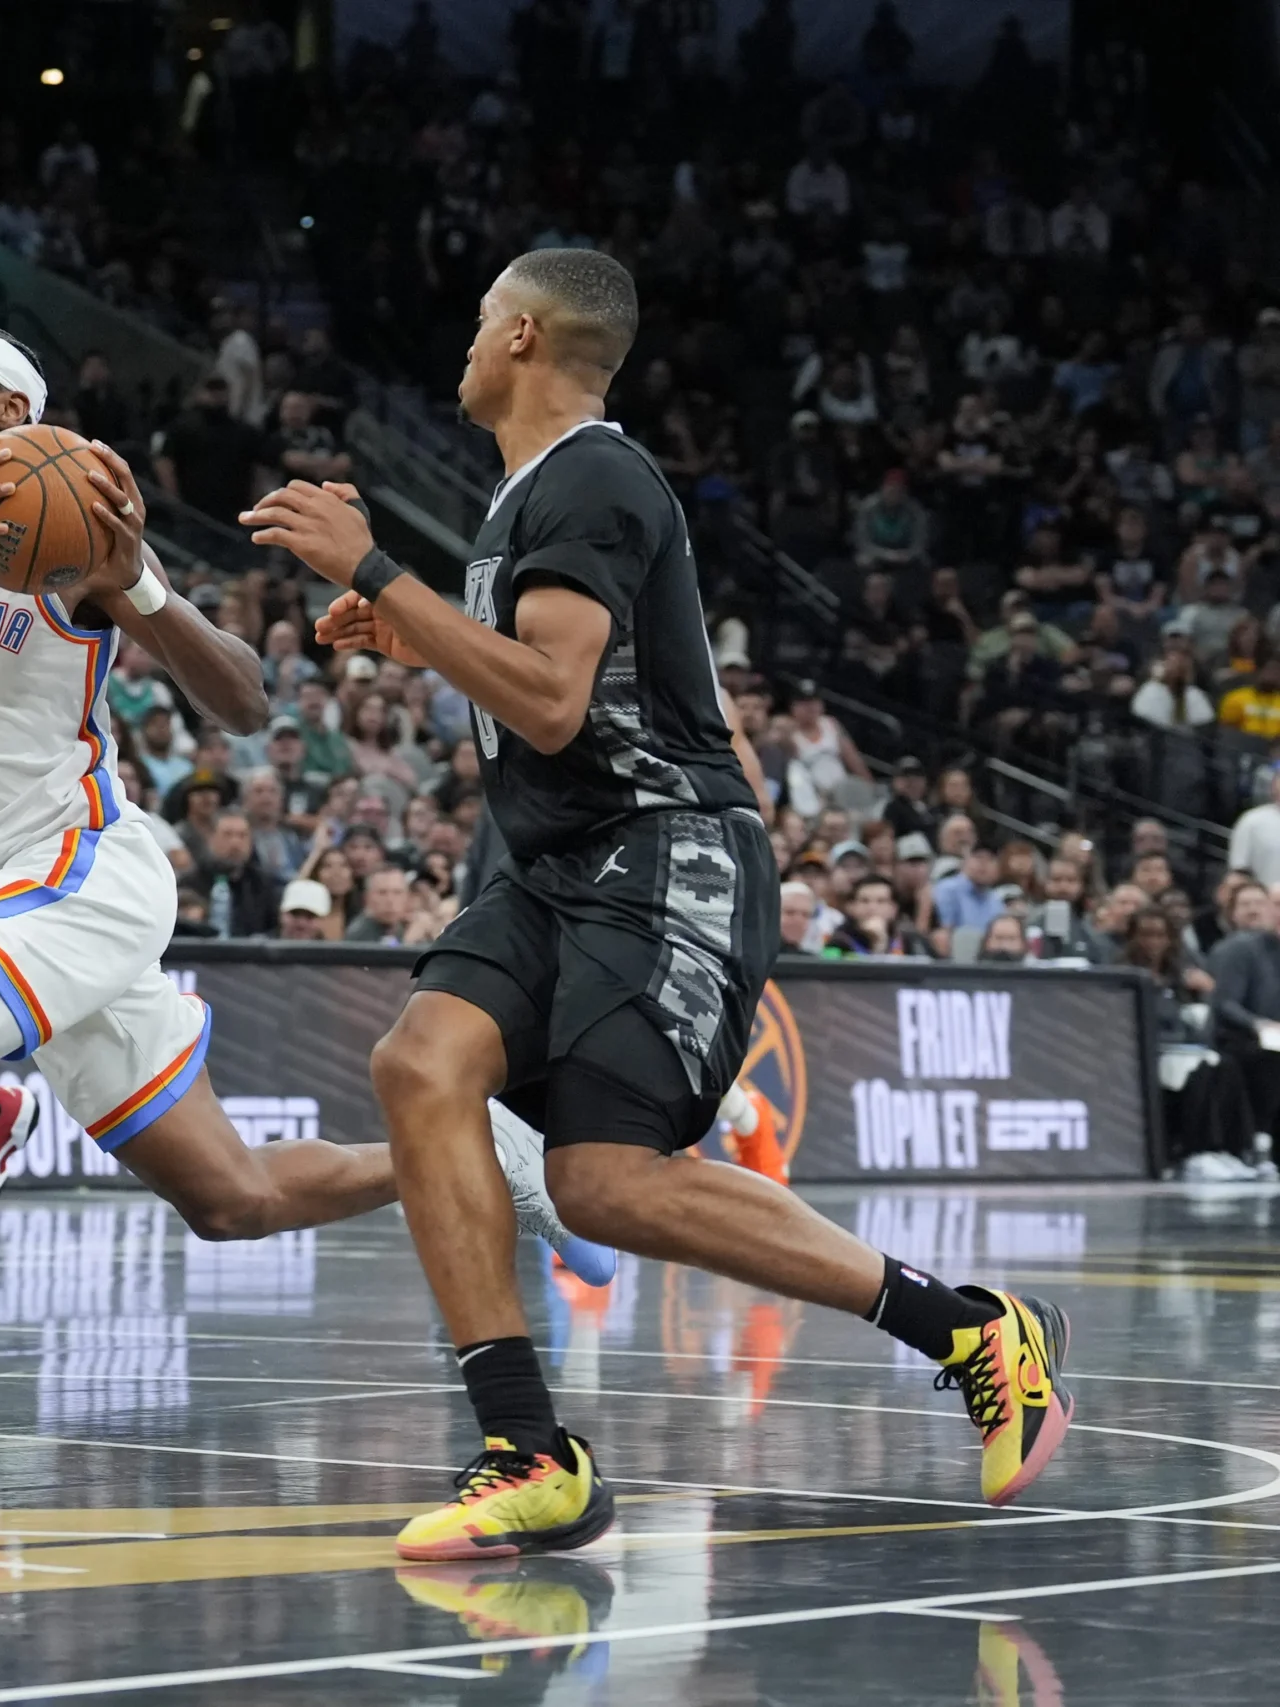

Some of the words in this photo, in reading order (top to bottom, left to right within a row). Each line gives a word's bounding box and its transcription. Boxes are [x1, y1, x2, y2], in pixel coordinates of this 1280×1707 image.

[897, 988, 1012, 1080] FRIDAY
[852, 1077, 941, 1170] 10PM
[942, 1089, 979, 1169] ET
[987, 1099, 1088, 1150] ESPN
